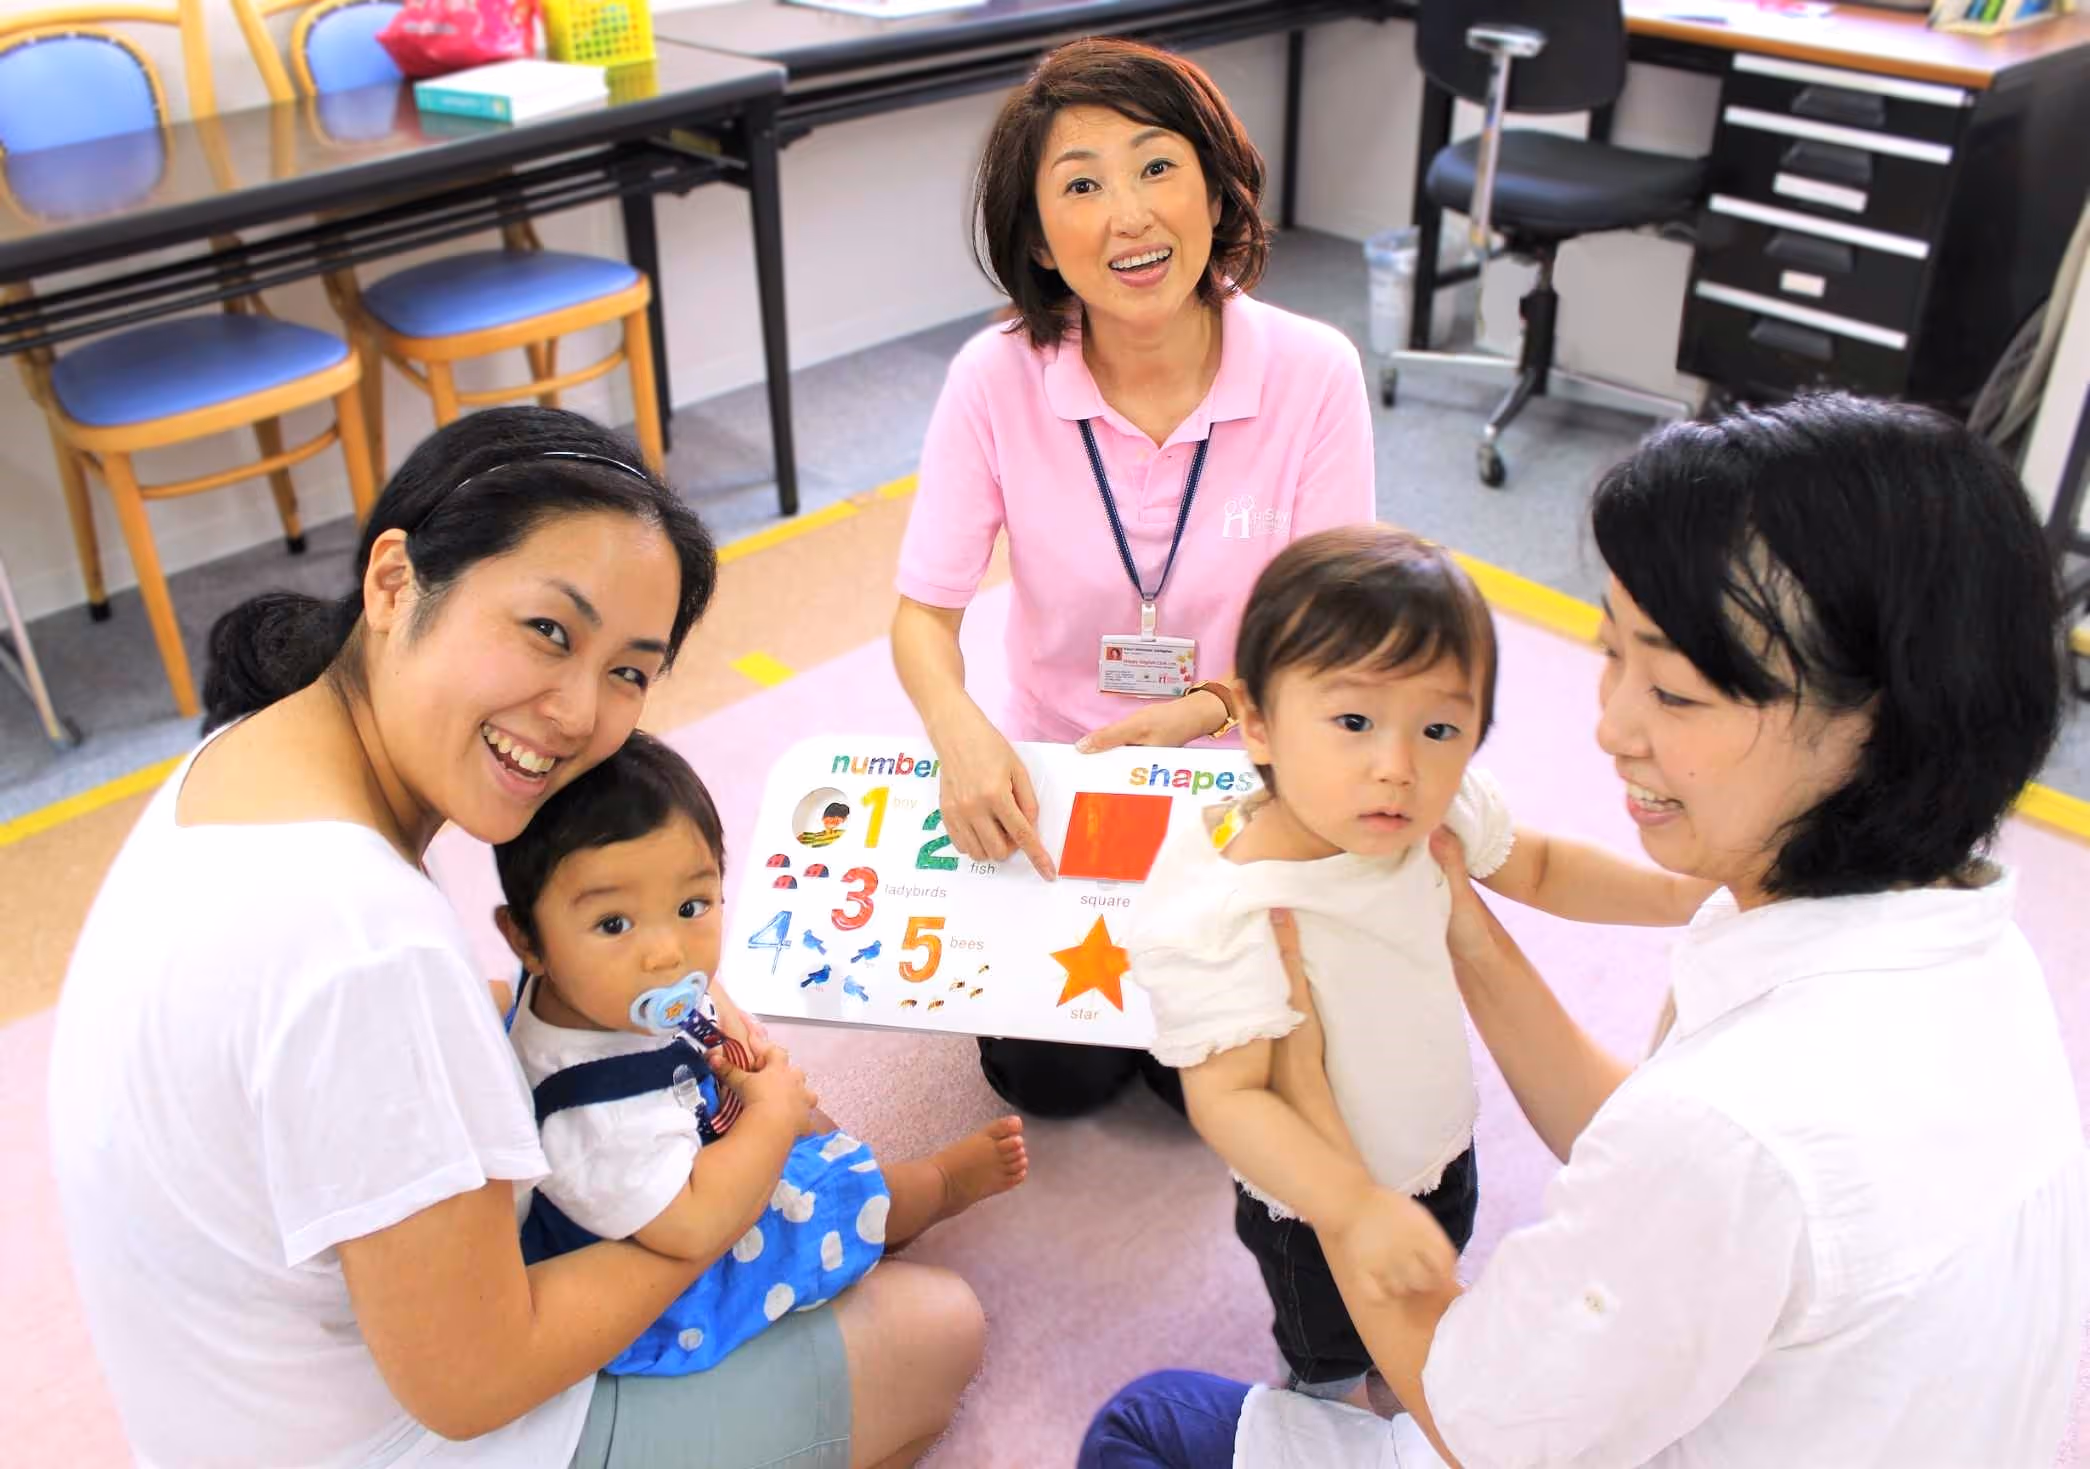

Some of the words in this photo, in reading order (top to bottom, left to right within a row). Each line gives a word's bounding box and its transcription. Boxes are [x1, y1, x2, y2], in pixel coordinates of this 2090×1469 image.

[1129, 764, 1252, 795] shapes
[860, 786, 890, 848] 1
[970, 862, 996, 875] fish
[831, 866, 879, 931] 3
[885, 884, 947, 899] ladybirds
[1080, 895, 1131, 908] square
[748, 910, 792, 975] 4
[899, 916, 946, 983] 5
[950, 936, 985, 950] bees
[1070, 1007, 1099, 1021] star
